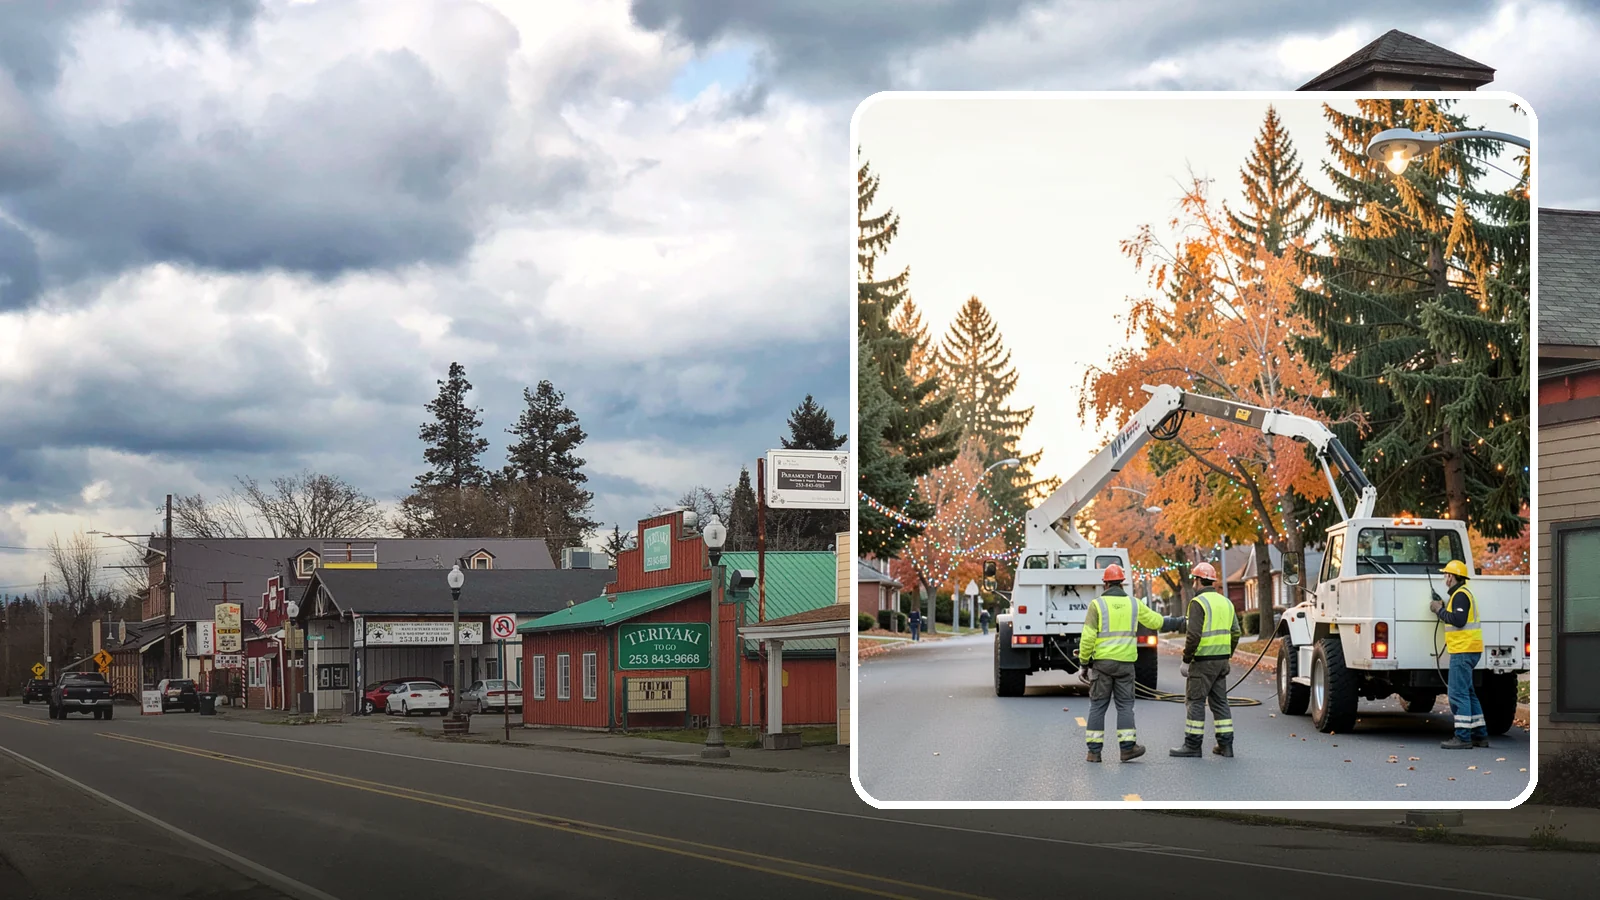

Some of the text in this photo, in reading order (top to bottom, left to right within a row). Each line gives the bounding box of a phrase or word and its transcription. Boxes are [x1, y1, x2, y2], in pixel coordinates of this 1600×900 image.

[781, 471, 839, 480] PARAMOUNT REALTY
[625, 627, 702, 645] TERIYAKI
[628, 653, 700, 664] 253 843-9668
